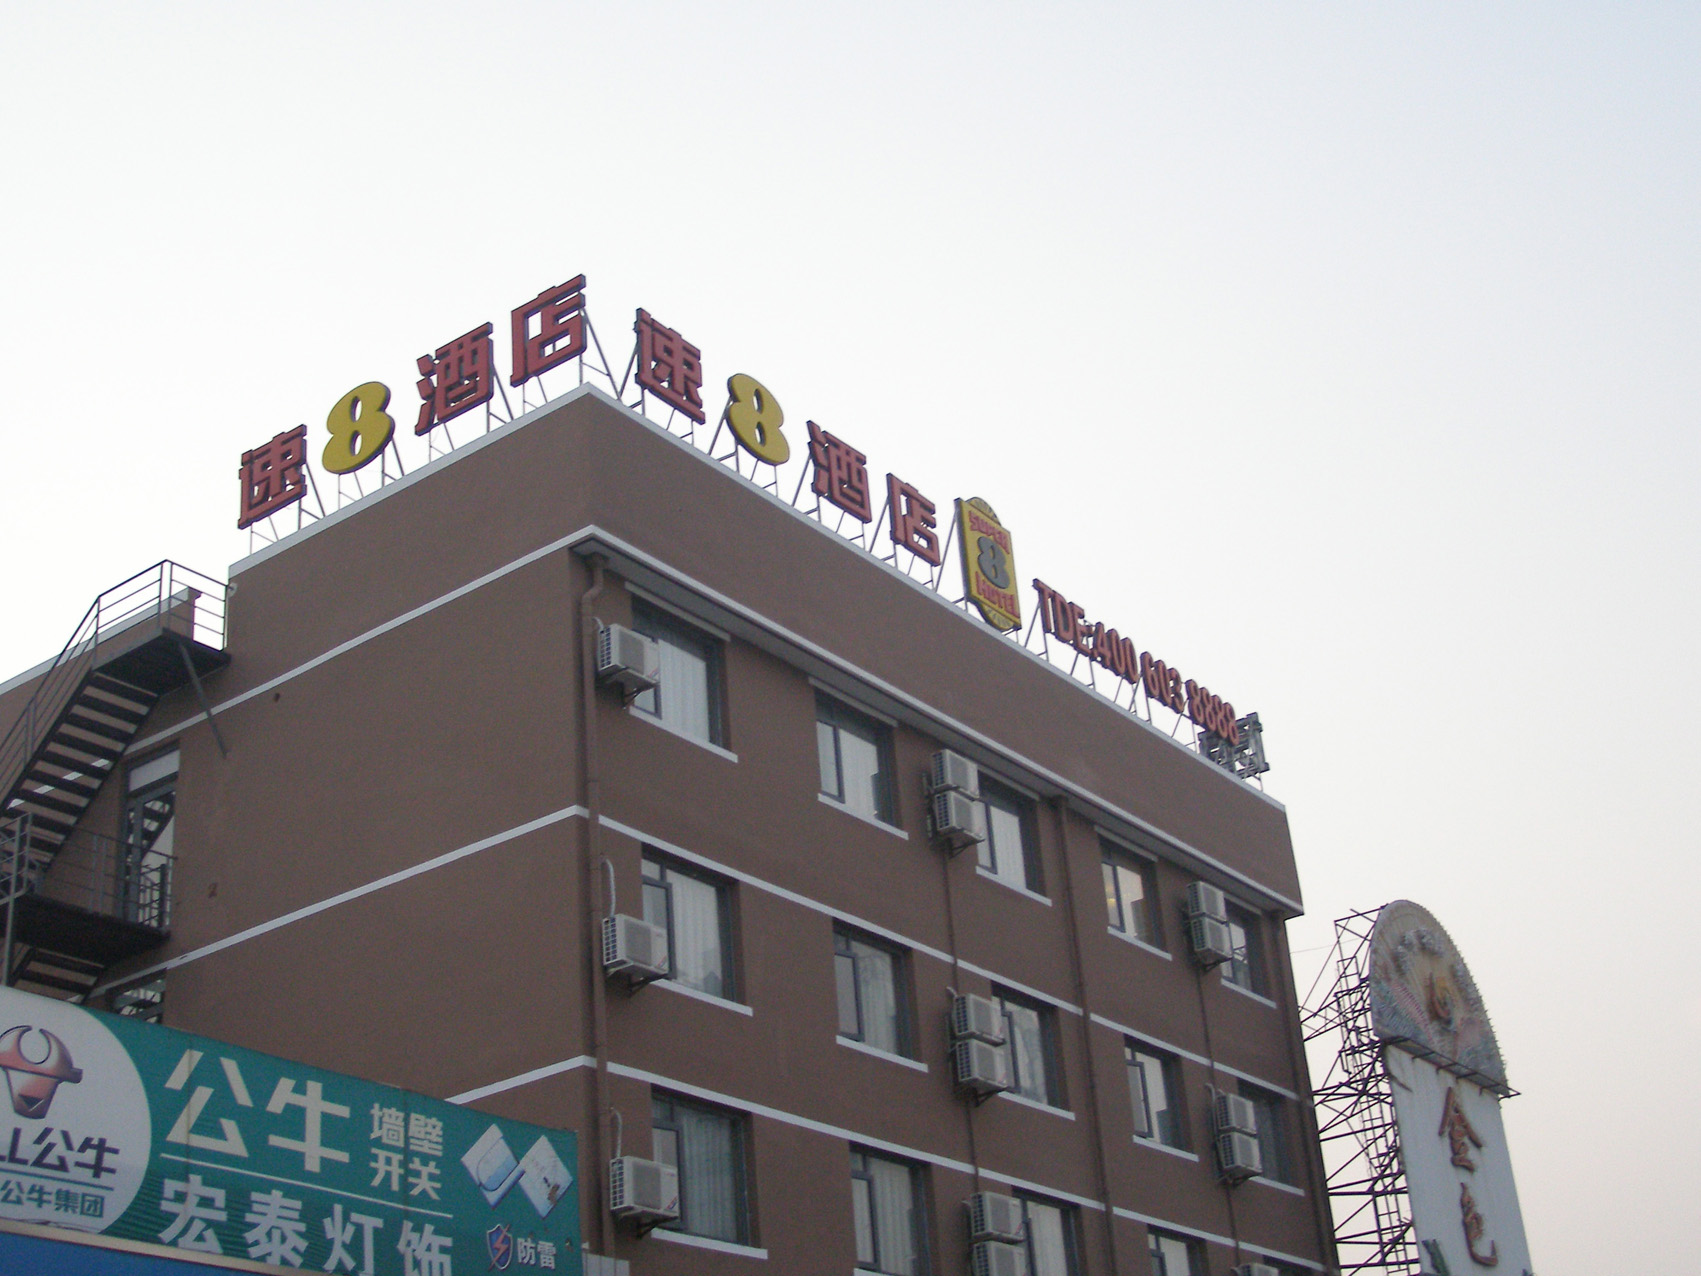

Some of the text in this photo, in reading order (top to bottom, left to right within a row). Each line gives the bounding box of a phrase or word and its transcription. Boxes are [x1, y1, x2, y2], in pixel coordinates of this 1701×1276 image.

[238, 274, 587, 530] 速8酒店
[633, 307, 941, 567] 速8酒店
[977, 536, 1010, 589] 8
[164, 1049, 351, 1173] 公牛
[370, 1103, 443, 1157] 墙壁
[0, 1179, 105, 1218] 公牛集团
[369, 1147, 442, 1201] 开关
[157, 1173, 453, 1276] 宏泰灯饰
[517, 1237, 557, 1270] 防雷
